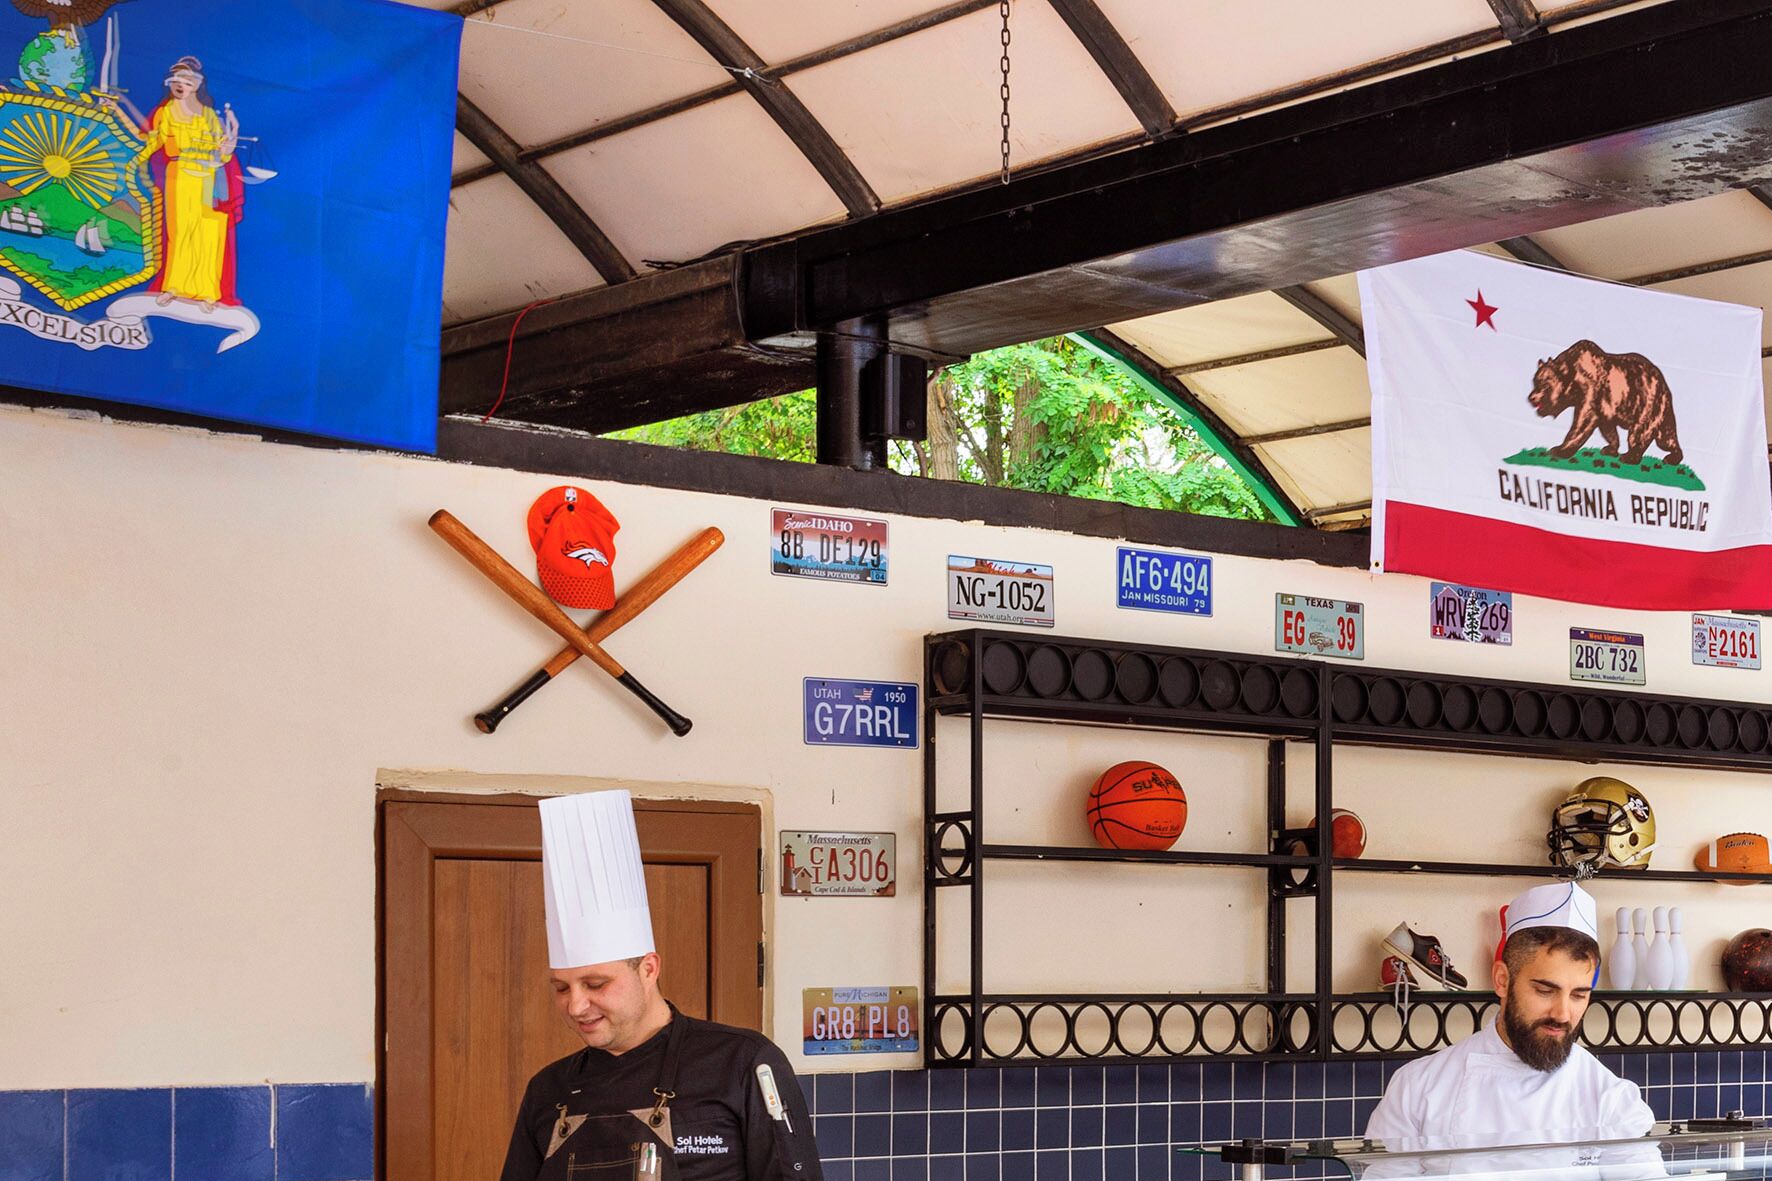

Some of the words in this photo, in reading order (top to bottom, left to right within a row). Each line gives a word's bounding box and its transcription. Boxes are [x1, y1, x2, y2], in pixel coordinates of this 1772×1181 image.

[0, 302, 146, 346] XCELSIOR
[1498, 468, 1618, 521] CALIFORNIA
[1631, 494, 1710, 532] REPUBLIC
[811, 517, 854, 533] IDAHO
[780, 529, 805, 560] 8B
[819, 533, 882, 568] DE129
[956, 575, 1046, 613] NG-1052
[1121, 590, 1142, 601] JAN
[1143, 592, 1189, 607] MISSOURI
[1305, 597, 1335, 610] TEXAS
[1283, 609, 1305, 646] EG
[1336, 615, 1356, 652] 39
[1480, 601, 1509, 632] 269
[1575, 644, 1605, 671] 2BC
[1609, 647, 1638, 673] 732
[813, 688, 842, 699] UTAH
[884, 692, 907, 703] 1950
[814, 701, 911, 739] G7RRL
[806, 834, 873, 846] Massachusetts
[812, 1006, 856, 1040] GR8
[868, 1005, 911, 1039] PL8
[676, 1136, 692, 1146] Sol
[694, 1135, 724, 1146] Hotels
